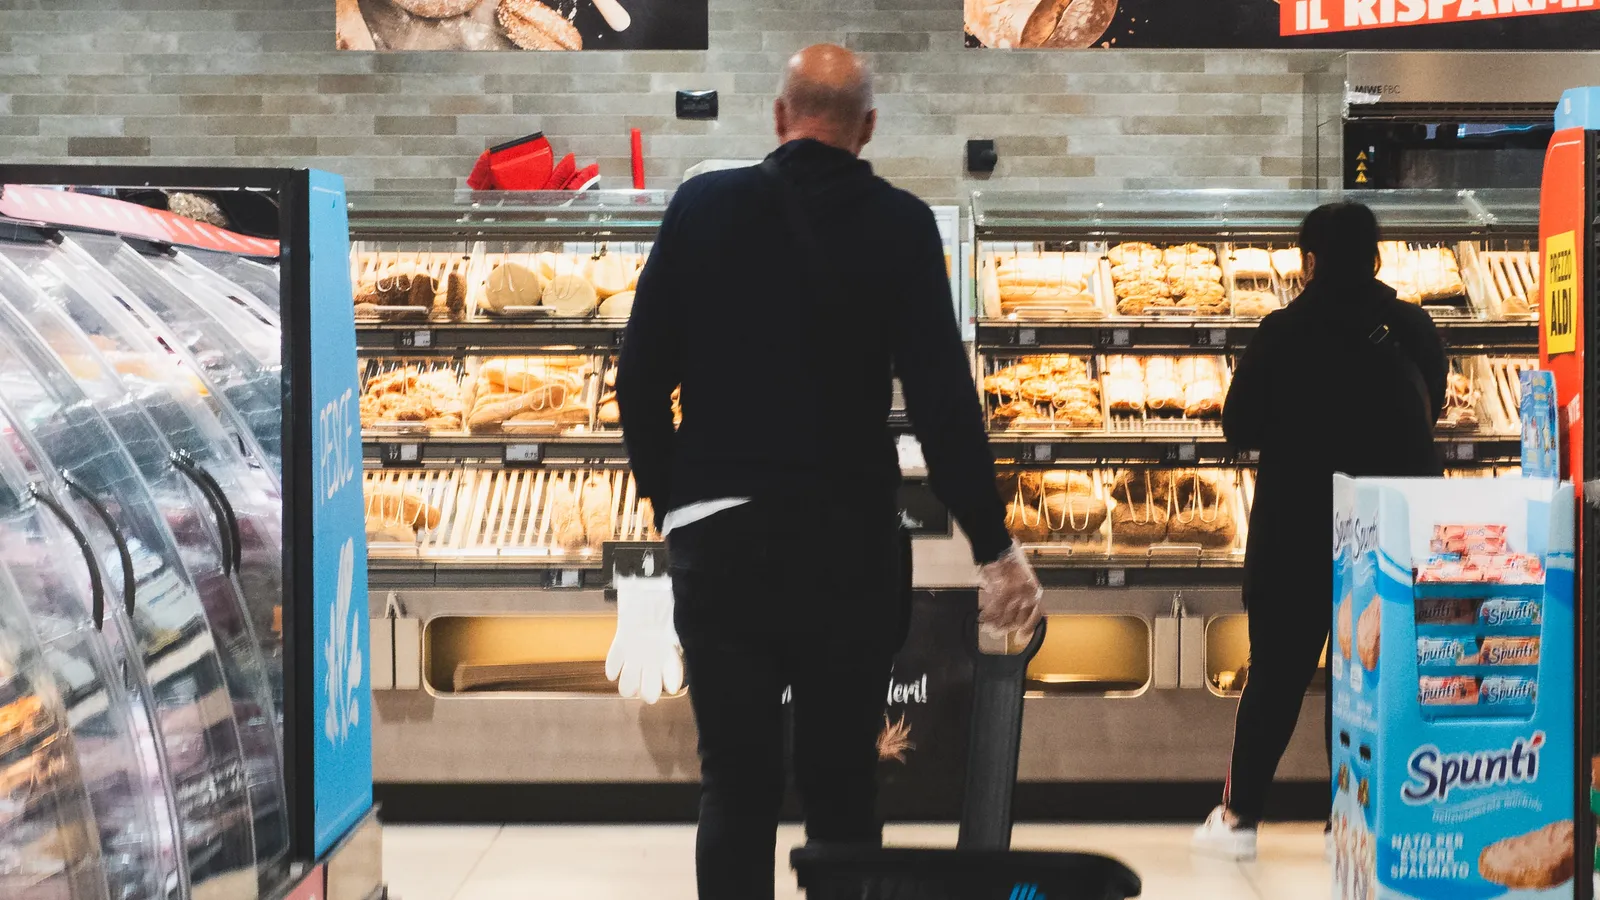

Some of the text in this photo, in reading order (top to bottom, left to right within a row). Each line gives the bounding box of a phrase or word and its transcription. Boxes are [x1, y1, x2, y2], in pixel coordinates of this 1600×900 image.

[1344, 0, 1594, 27] RISPA
[1355, 85, 1382, 94] MIWE
[1551, 288, 1572, 336] ALDI
[320, 388, 354, 505] PESCE
[1417, 602, 1451, 621] punti
